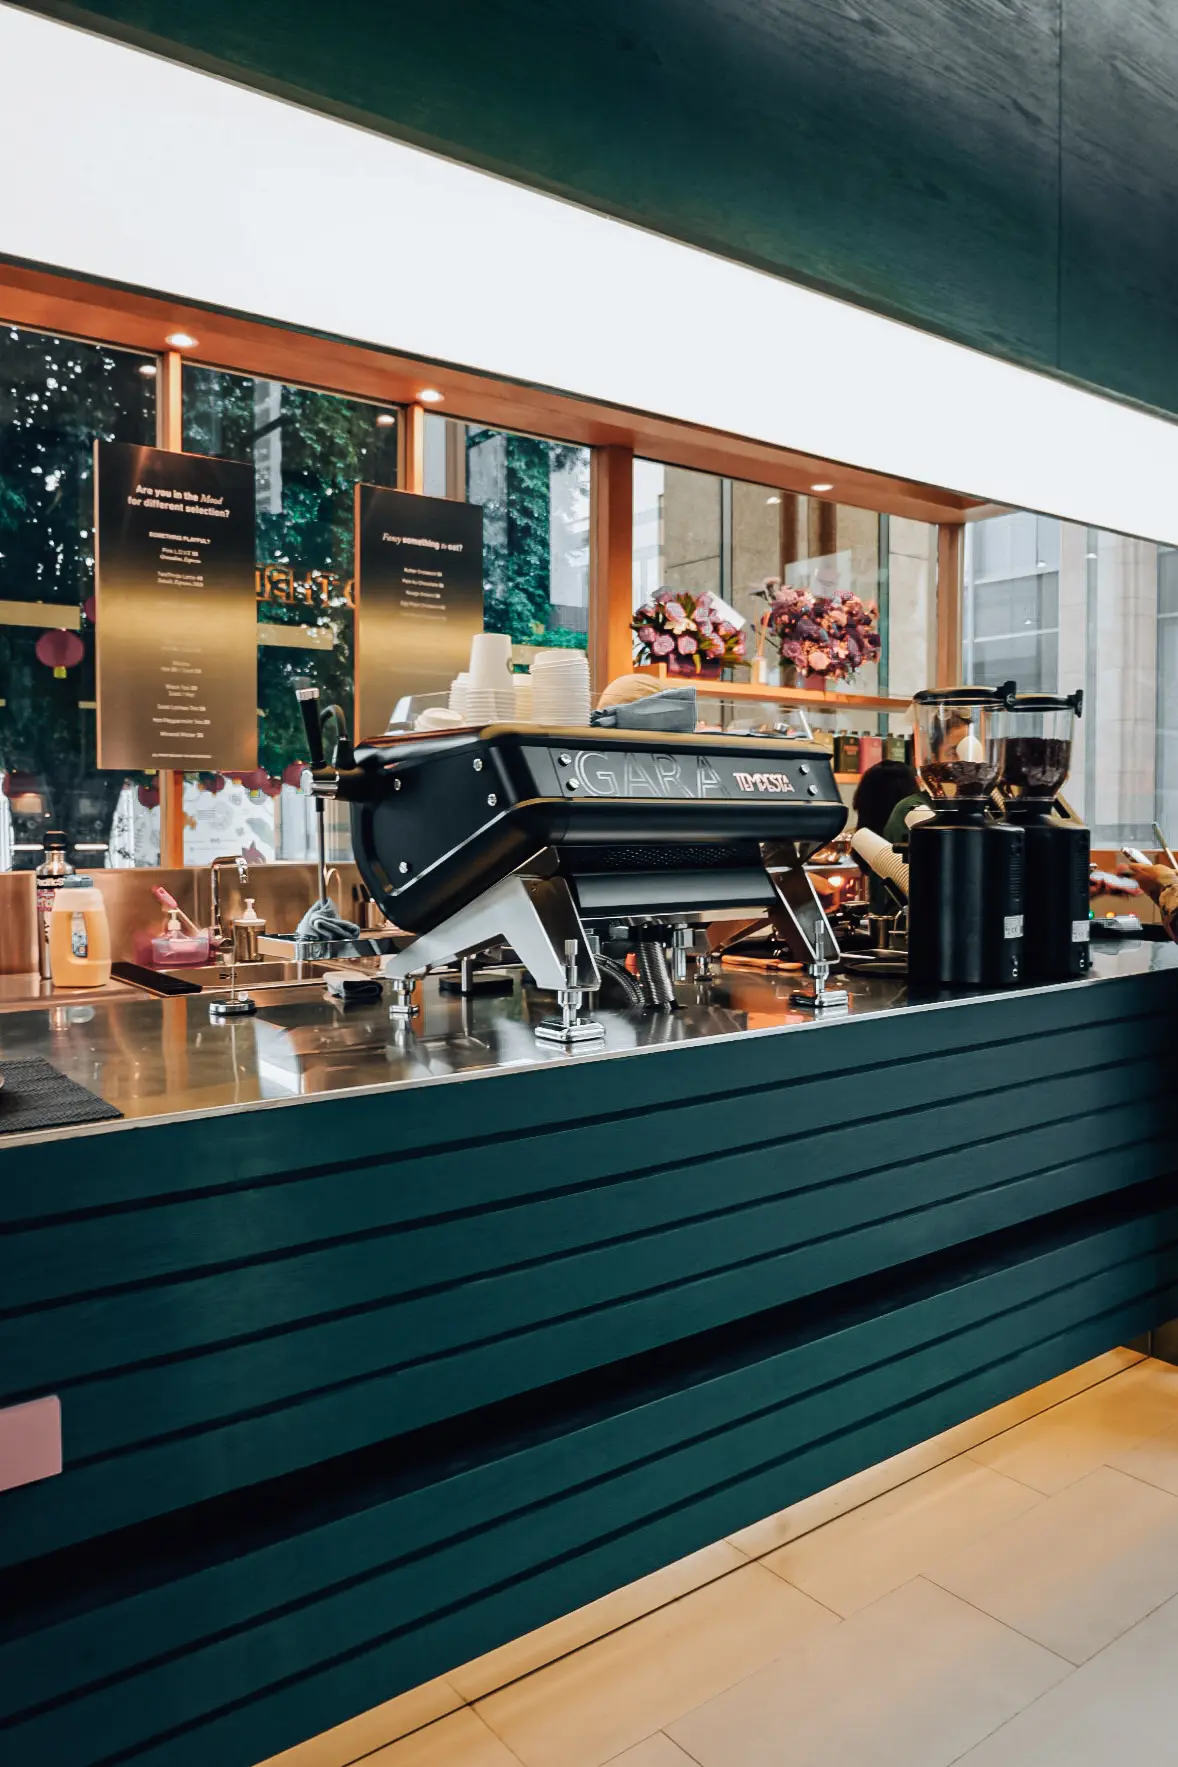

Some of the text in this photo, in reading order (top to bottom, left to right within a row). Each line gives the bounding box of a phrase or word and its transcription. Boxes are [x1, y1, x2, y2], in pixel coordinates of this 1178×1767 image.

[136, 485, 153, 495] Are
[155, 489, 171, 498] you
[173, 490, 182, 499] in
[183, 491, 199, 501] the
[128, 496, 229, 517] for different selection?
[402, 537, 440, 550] something
[733, 772, 796, 793] TEMPESTA
